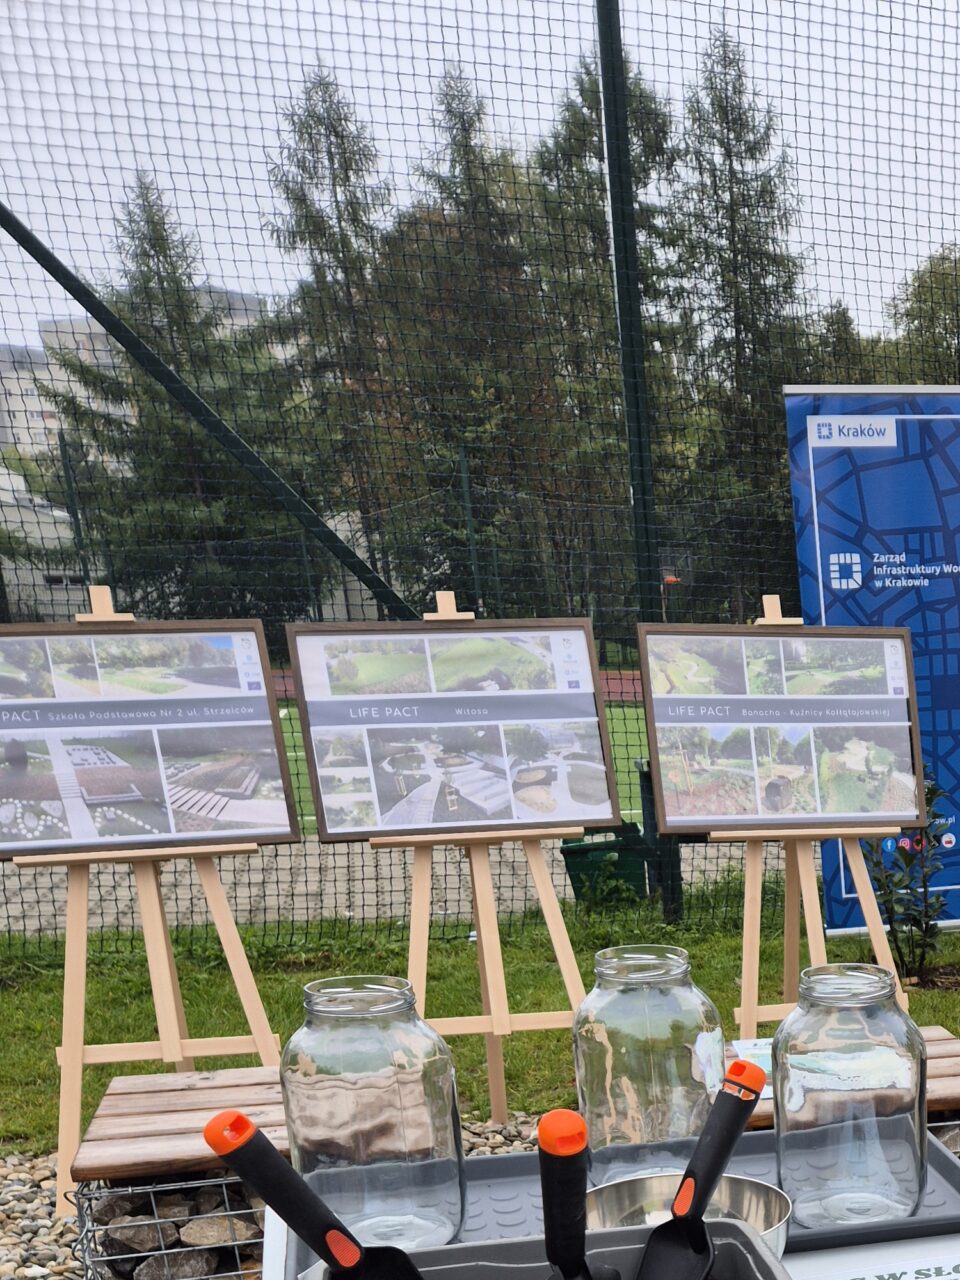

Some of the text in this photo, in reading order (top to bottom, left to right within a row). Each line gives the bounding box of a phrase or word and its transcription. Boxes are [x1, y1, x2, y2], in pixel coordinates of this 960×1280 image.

[838, 423, 887, 438] Kraków
[873, 552, 906, 564] Zarząd
[873, 564, 941, 576] Infrastruktury
[885, 577, 930, 587] Krakowie
[1, 710, 40, 721] PACT
[48, 711, 85, 721] Szkoła
[89, 709, 156, 719] Podstawowa
[160, 709, 172, 717] Nr
[177, 709, 182, 717] 2
[187, 707, 199, 716] ul.
[350, 706, 488, 718] LIFE PACT Witosa
[668, 705, 695, 716] LIFE
[700, 705, 731, 716] PACT
[742, 708, 780, 716] Banacha
